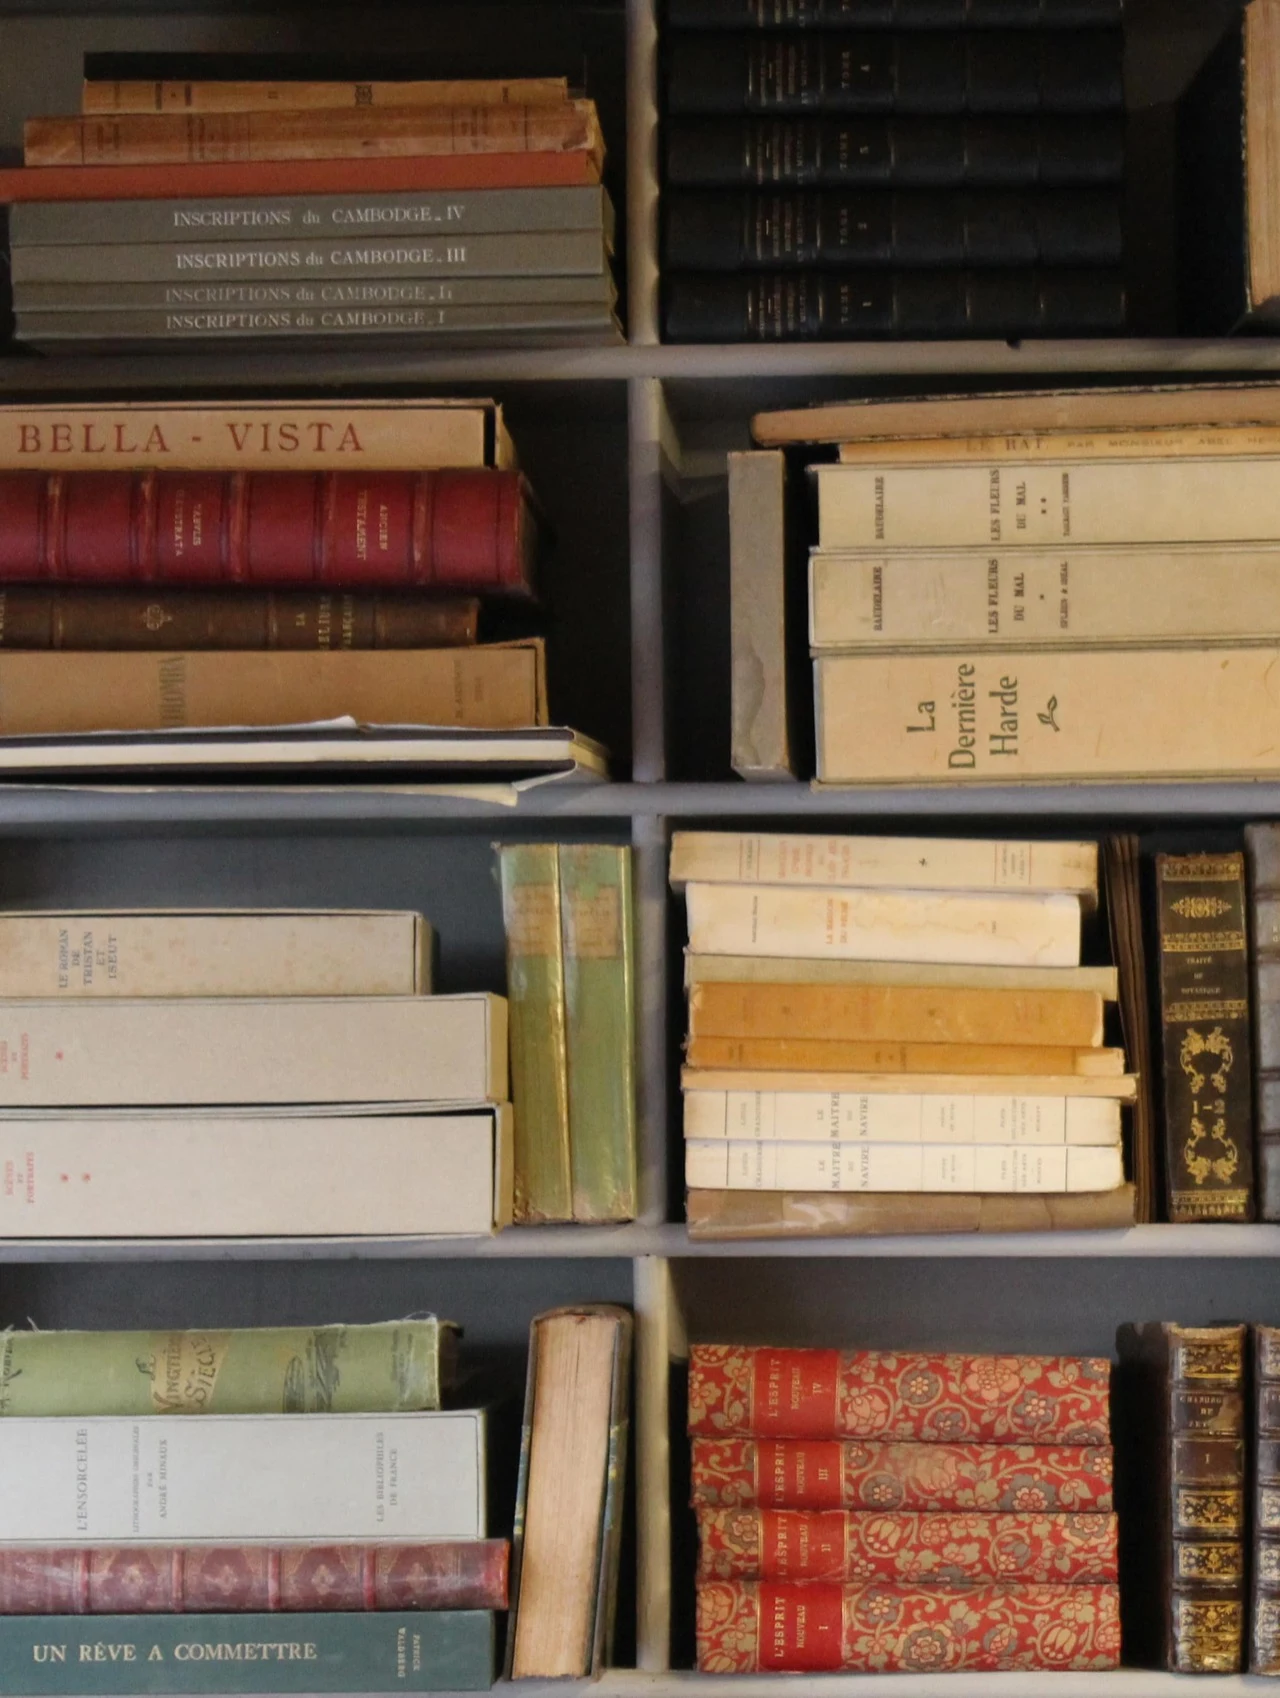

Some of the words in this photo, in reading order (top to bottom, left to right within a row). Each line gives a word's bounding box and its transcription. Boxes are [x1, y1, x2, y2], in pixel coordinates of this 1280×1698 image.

[173, 210, 291, 227] INSCRIPTIONS
[302, 210, 321, 225] du
[176, 252, 300, 270] INSCRIPTIONS
[305, 251, 324, 266] du
[165, 287, 291, 303] INSCRIPTIONS
[296, 287, 315, 301] du
[166, 313, 291, 329] INSCRIPTIONS
[296, 313, 315, 327] du
[18, 424, 171, 452] BELLA
[226, 423, 365, 452] VISTA
[875, 476, 885, 540] BAUDELAIRE
[991, 468, 1001, 515] FLEURS
[1016, 481, 1026, 505] MAL
[356, 490, 367, 561] TESTAMENT
[379, 504, 389, 551] ANCIEN
[990, 517, 1000, 541] LES
[1017, 512, 1027, 530] DU
[873, 566, 883, 631] BAUDELAIRE
[989, 558, 999, 605] FLEURS
[1014, 572, 1024, 596] MAL
[989, 609, 998, 634] LES
[1014, 603, 1024, 621] DU
[906, 700, 935, 734] La
[948, 663, 976, 770] Dernière
[989, 675, 1019, 756] Harde
[83, 931, 92, 986] TRISTAN
[96, 950, 105, 966] ET
[108, 934, 117, 979] ISEUT
[817, 1109, 824, 1120] LE
[830, 1091, 840, 1137] MAITRE
[860, 1096, 868, 1136] NAVIRE
[818, 1160, 825, 1171] LE
[832, 1142, 841, 1189] MAITRE
[861, 1145, 869, 1187] NAVIRE
[769, 1359, 780, 1417] L'ESPRIT
[792, 1367, 800, 1410] NOUVEAU
[813, 1382, 823, 1394] IV
[77, 1428, 88, 1531] L'ENSORCELÉE
[158, 1439, 168, 1480] MINAUX
[376, 1432, 384, 1500] BIBLIOPHILES
[775, 1444, 785, 1502] L'ESPRIT
[796, 1452, 805, 1494] NOUVEAU
[818, 1468, 829, 1481] III
[158, 1484, 168, 1519] ANDRÉ
[376, 1503, 384, 1522] LES
[390, 1492, 397, 1506] DE
[777, 1517, 787, 1575] L'ESPRIT
[800, 1524, 808, 1567] NOUVEAU
[821, 1544, 831, 1552] II
[775, 1597, 786, 1658] L'ESPRIT
[796, 1605, 805, 1648] NOUVEAU
[33, 1645, 67, 1663] UN
[79, 1641, 136, 1662] RÊVE
[148, 1646, 163, 1661] A
[174, 1643, 318, 1661] COMMETTRE
